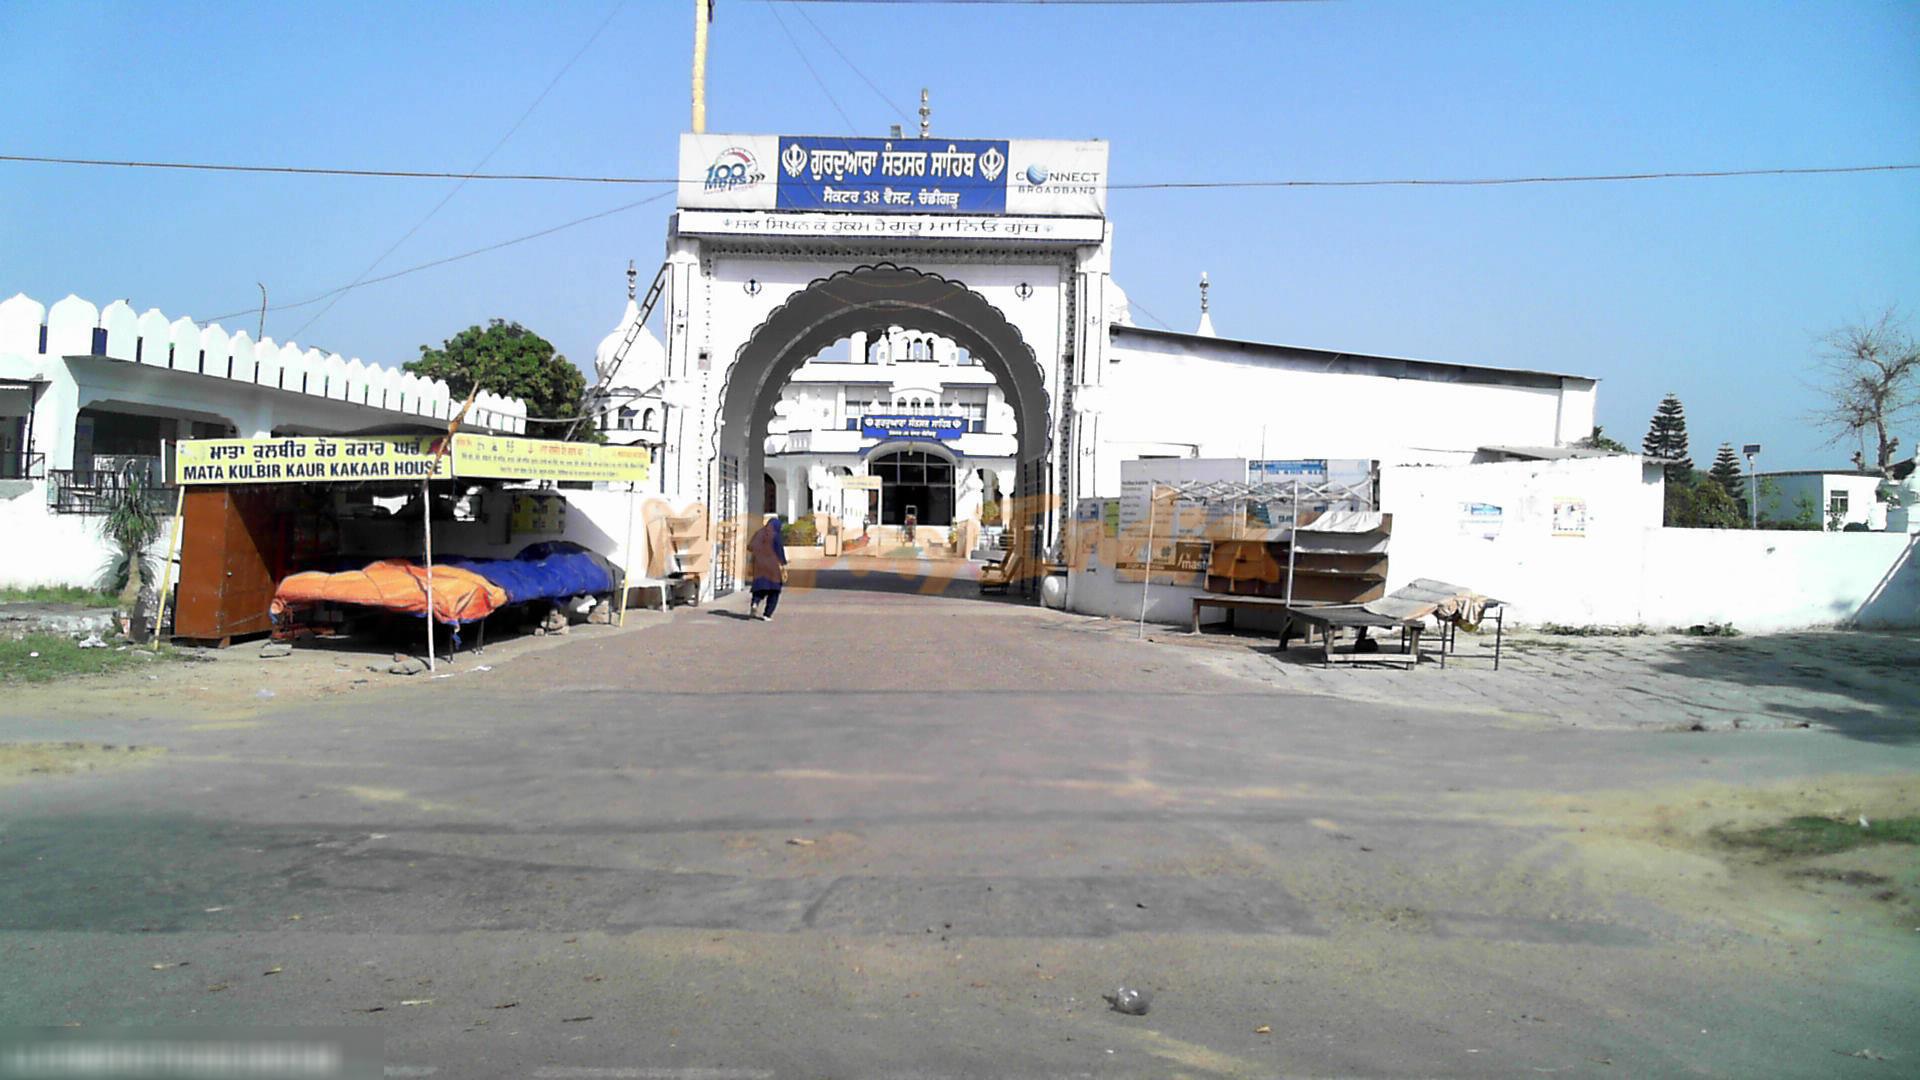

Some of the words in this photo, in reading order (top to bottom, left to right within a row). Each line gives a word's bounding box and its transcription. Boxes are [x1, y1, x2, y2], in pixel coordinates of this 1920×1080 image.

[810, 150, 878, 181] ਗੁਰਦੁਆਰਾ
[882, 142, 927, 176] ਸੰਤਸਰ
[930, 144, 976, 177] ਸਾਹਿਬ
[704, 163, 746, 180] 100
[1015, 165, 1100, 184] CONNECT
[823, 186, 861, 204] ਸੈਕਟਰ
[863, 190, 880, 205] 38
[1018, 185, 1097, 195] BROADBAND
[210, 445, 245, 460] ਮਾਤਾ
[252, 439, 306, 463] ਕੁਲਬੀਰ
[345, 441, 385, 457] ਕਕਾਰ
[183, 464, 224, 480] MATA
[229, 464, 281, 479] KULBIR
[286, 463, 326, 477] KAUR
[330, 462, 390, 477] KAKAAR
[394, 460, 443, 476] HOUSE
